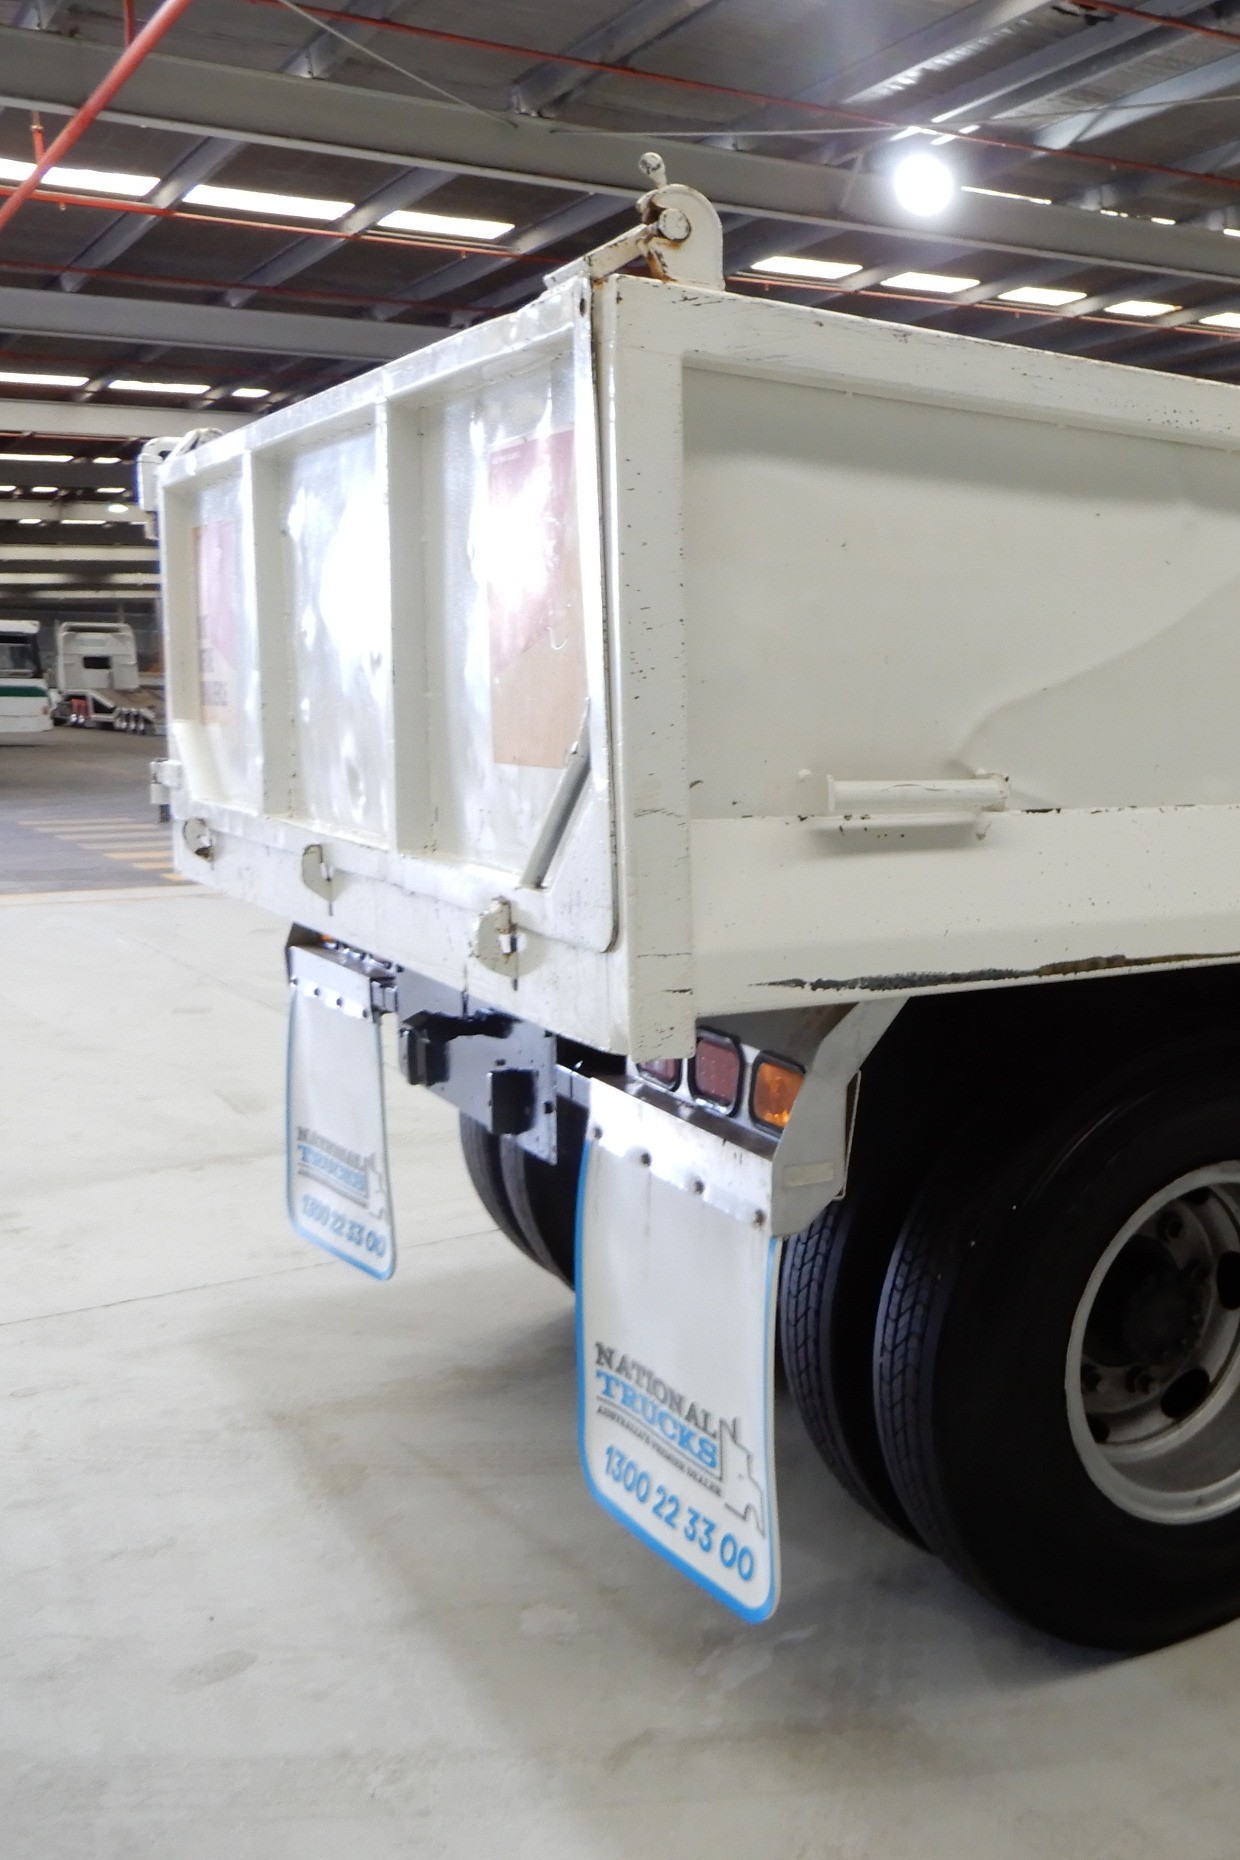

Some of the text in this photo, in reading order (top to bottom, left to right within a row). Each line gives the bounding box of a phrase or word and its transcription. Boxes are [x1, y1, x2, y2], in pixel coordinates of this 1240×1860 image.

[595, 1341, 717, 1439] NATIONAL
[596, 1369, 718, 1469] TRUCKS
[606, 1445, 651, 1503] 1300
[652, 1484, 681, 1529] 22
[684, 1506, 716, 1552] 33
[719, 1533, 755, 1581] 00
